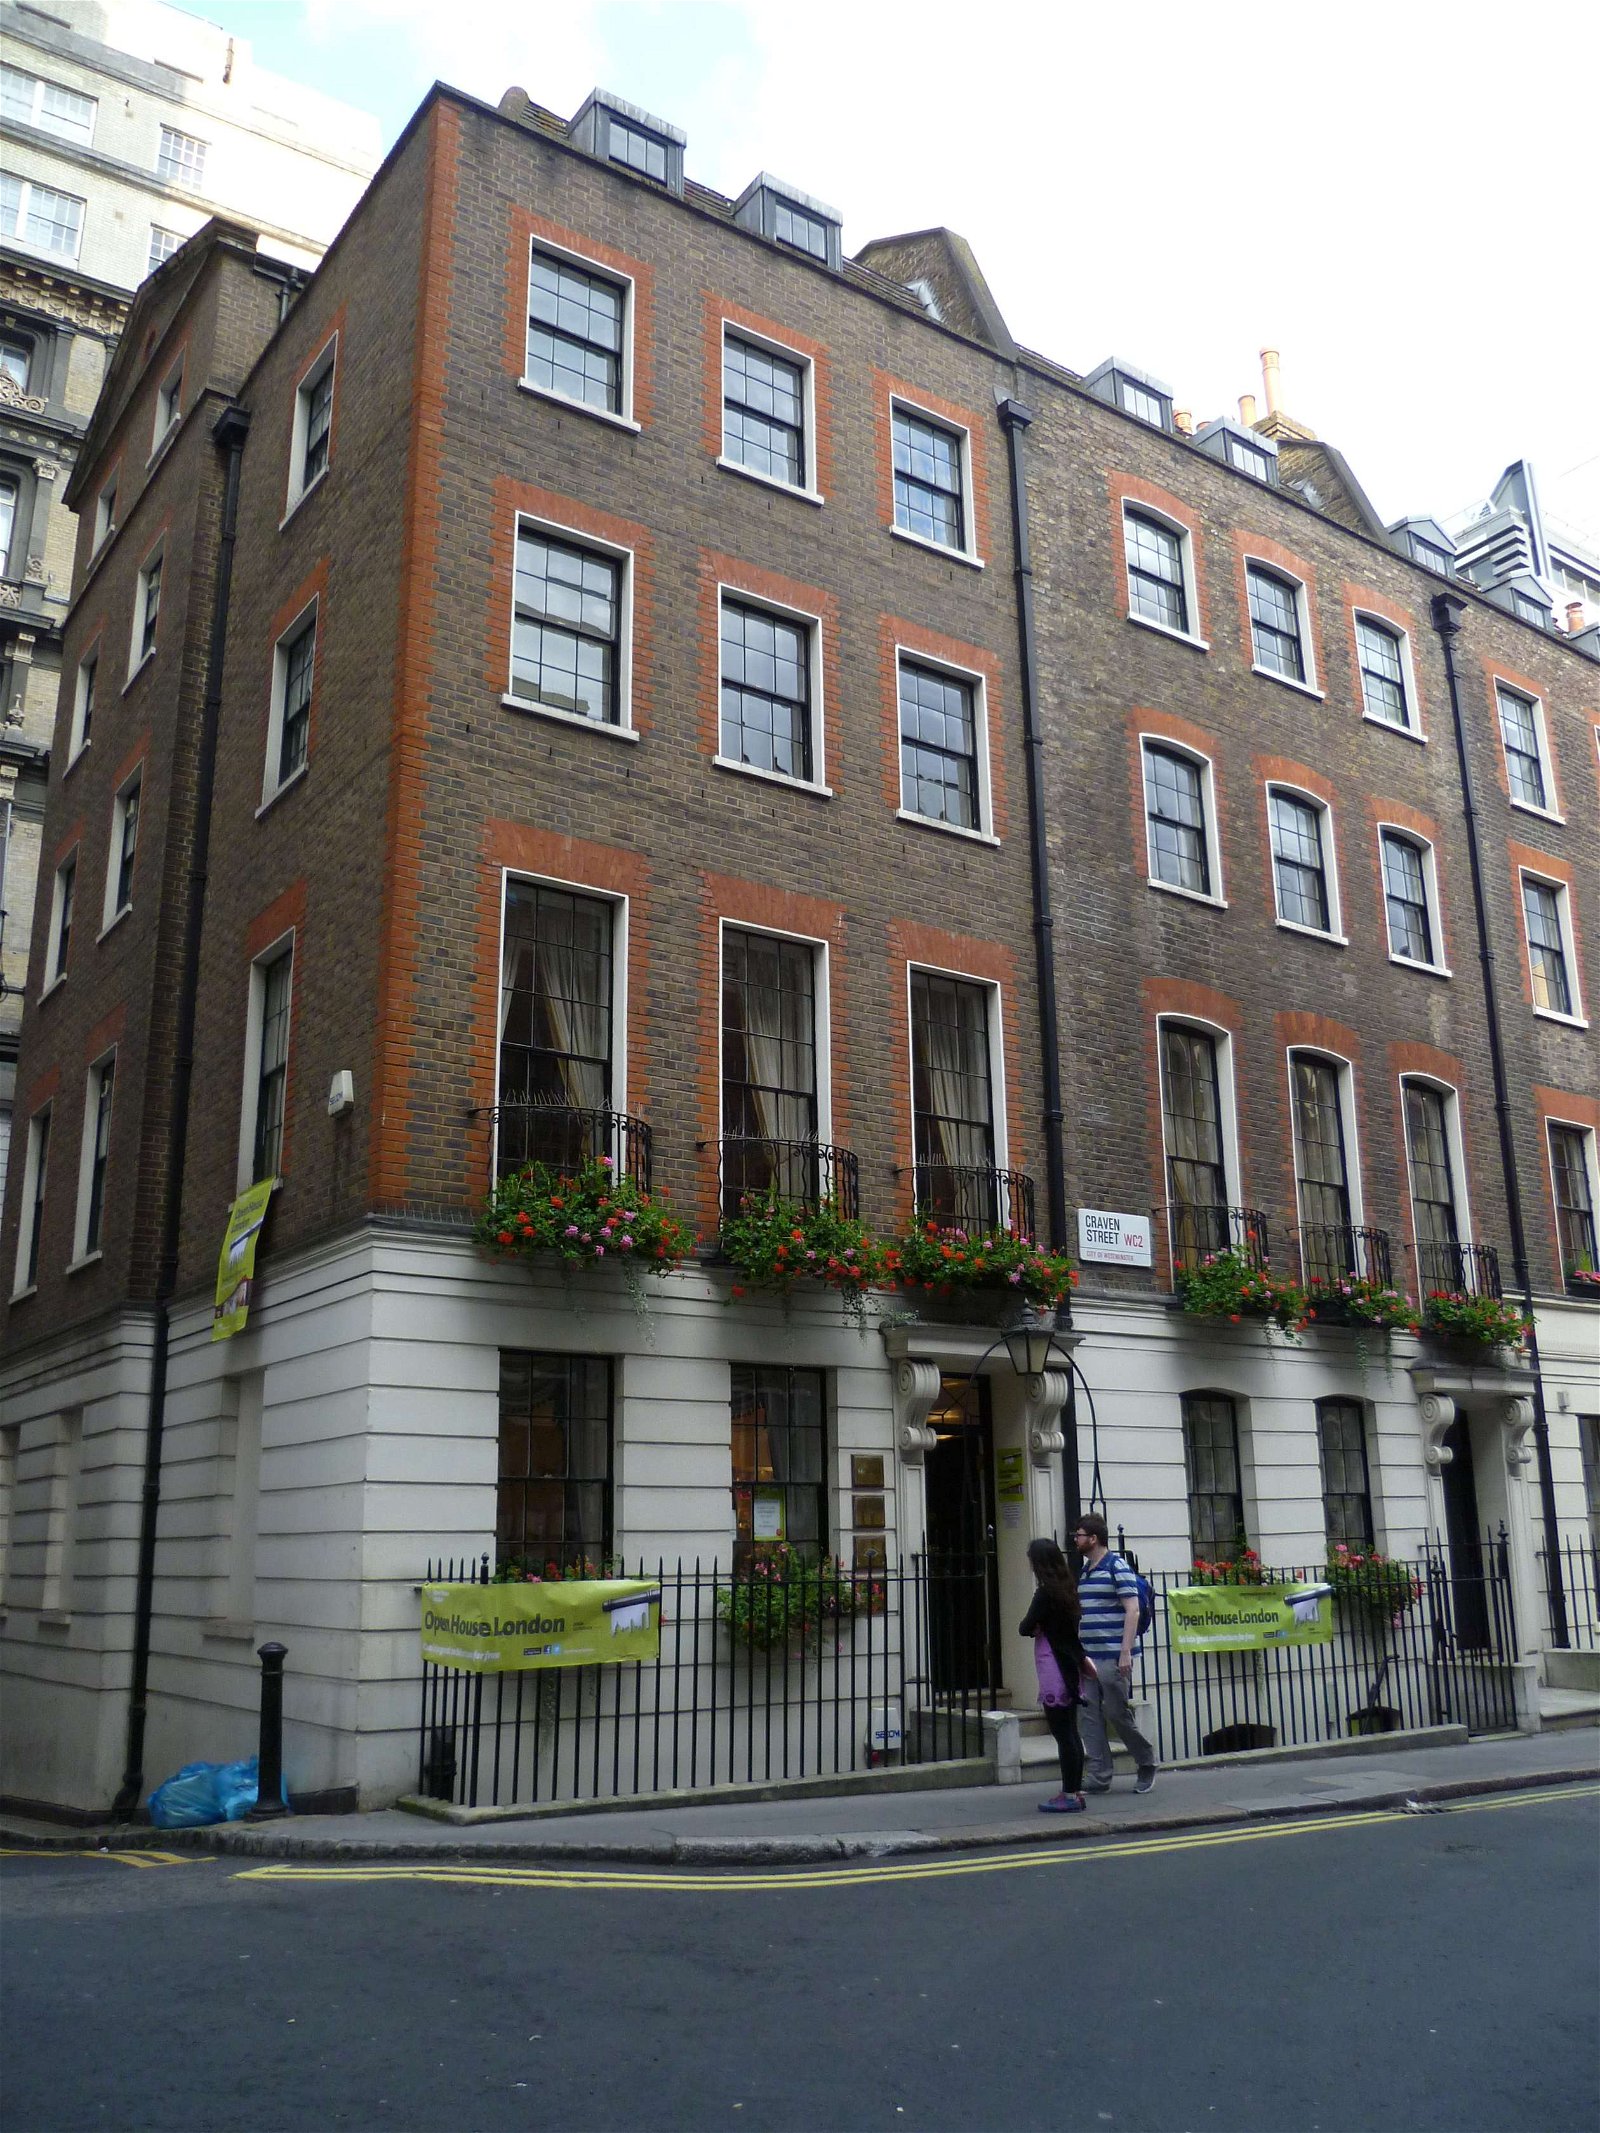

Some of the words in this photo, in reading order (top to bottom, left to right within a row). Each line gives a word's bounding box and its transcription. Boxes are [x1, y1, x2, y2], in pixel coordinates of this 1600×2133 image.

[1085, 1214, 1120, 1231] CRAVEN
[1086, 1229, 1119, 1245] STREET
[1123, 1233, 1144, 1248] WC2
[424, 1610, 450, 1636] Open
[451, 1614, 492, 1637] House
[494, 1613, 565, 1637] London
[1176, 1611, 1204, 1631] Open
[1205, 1610, 1238, 1626] House
[1238, 1608, 1279, 1624] London
